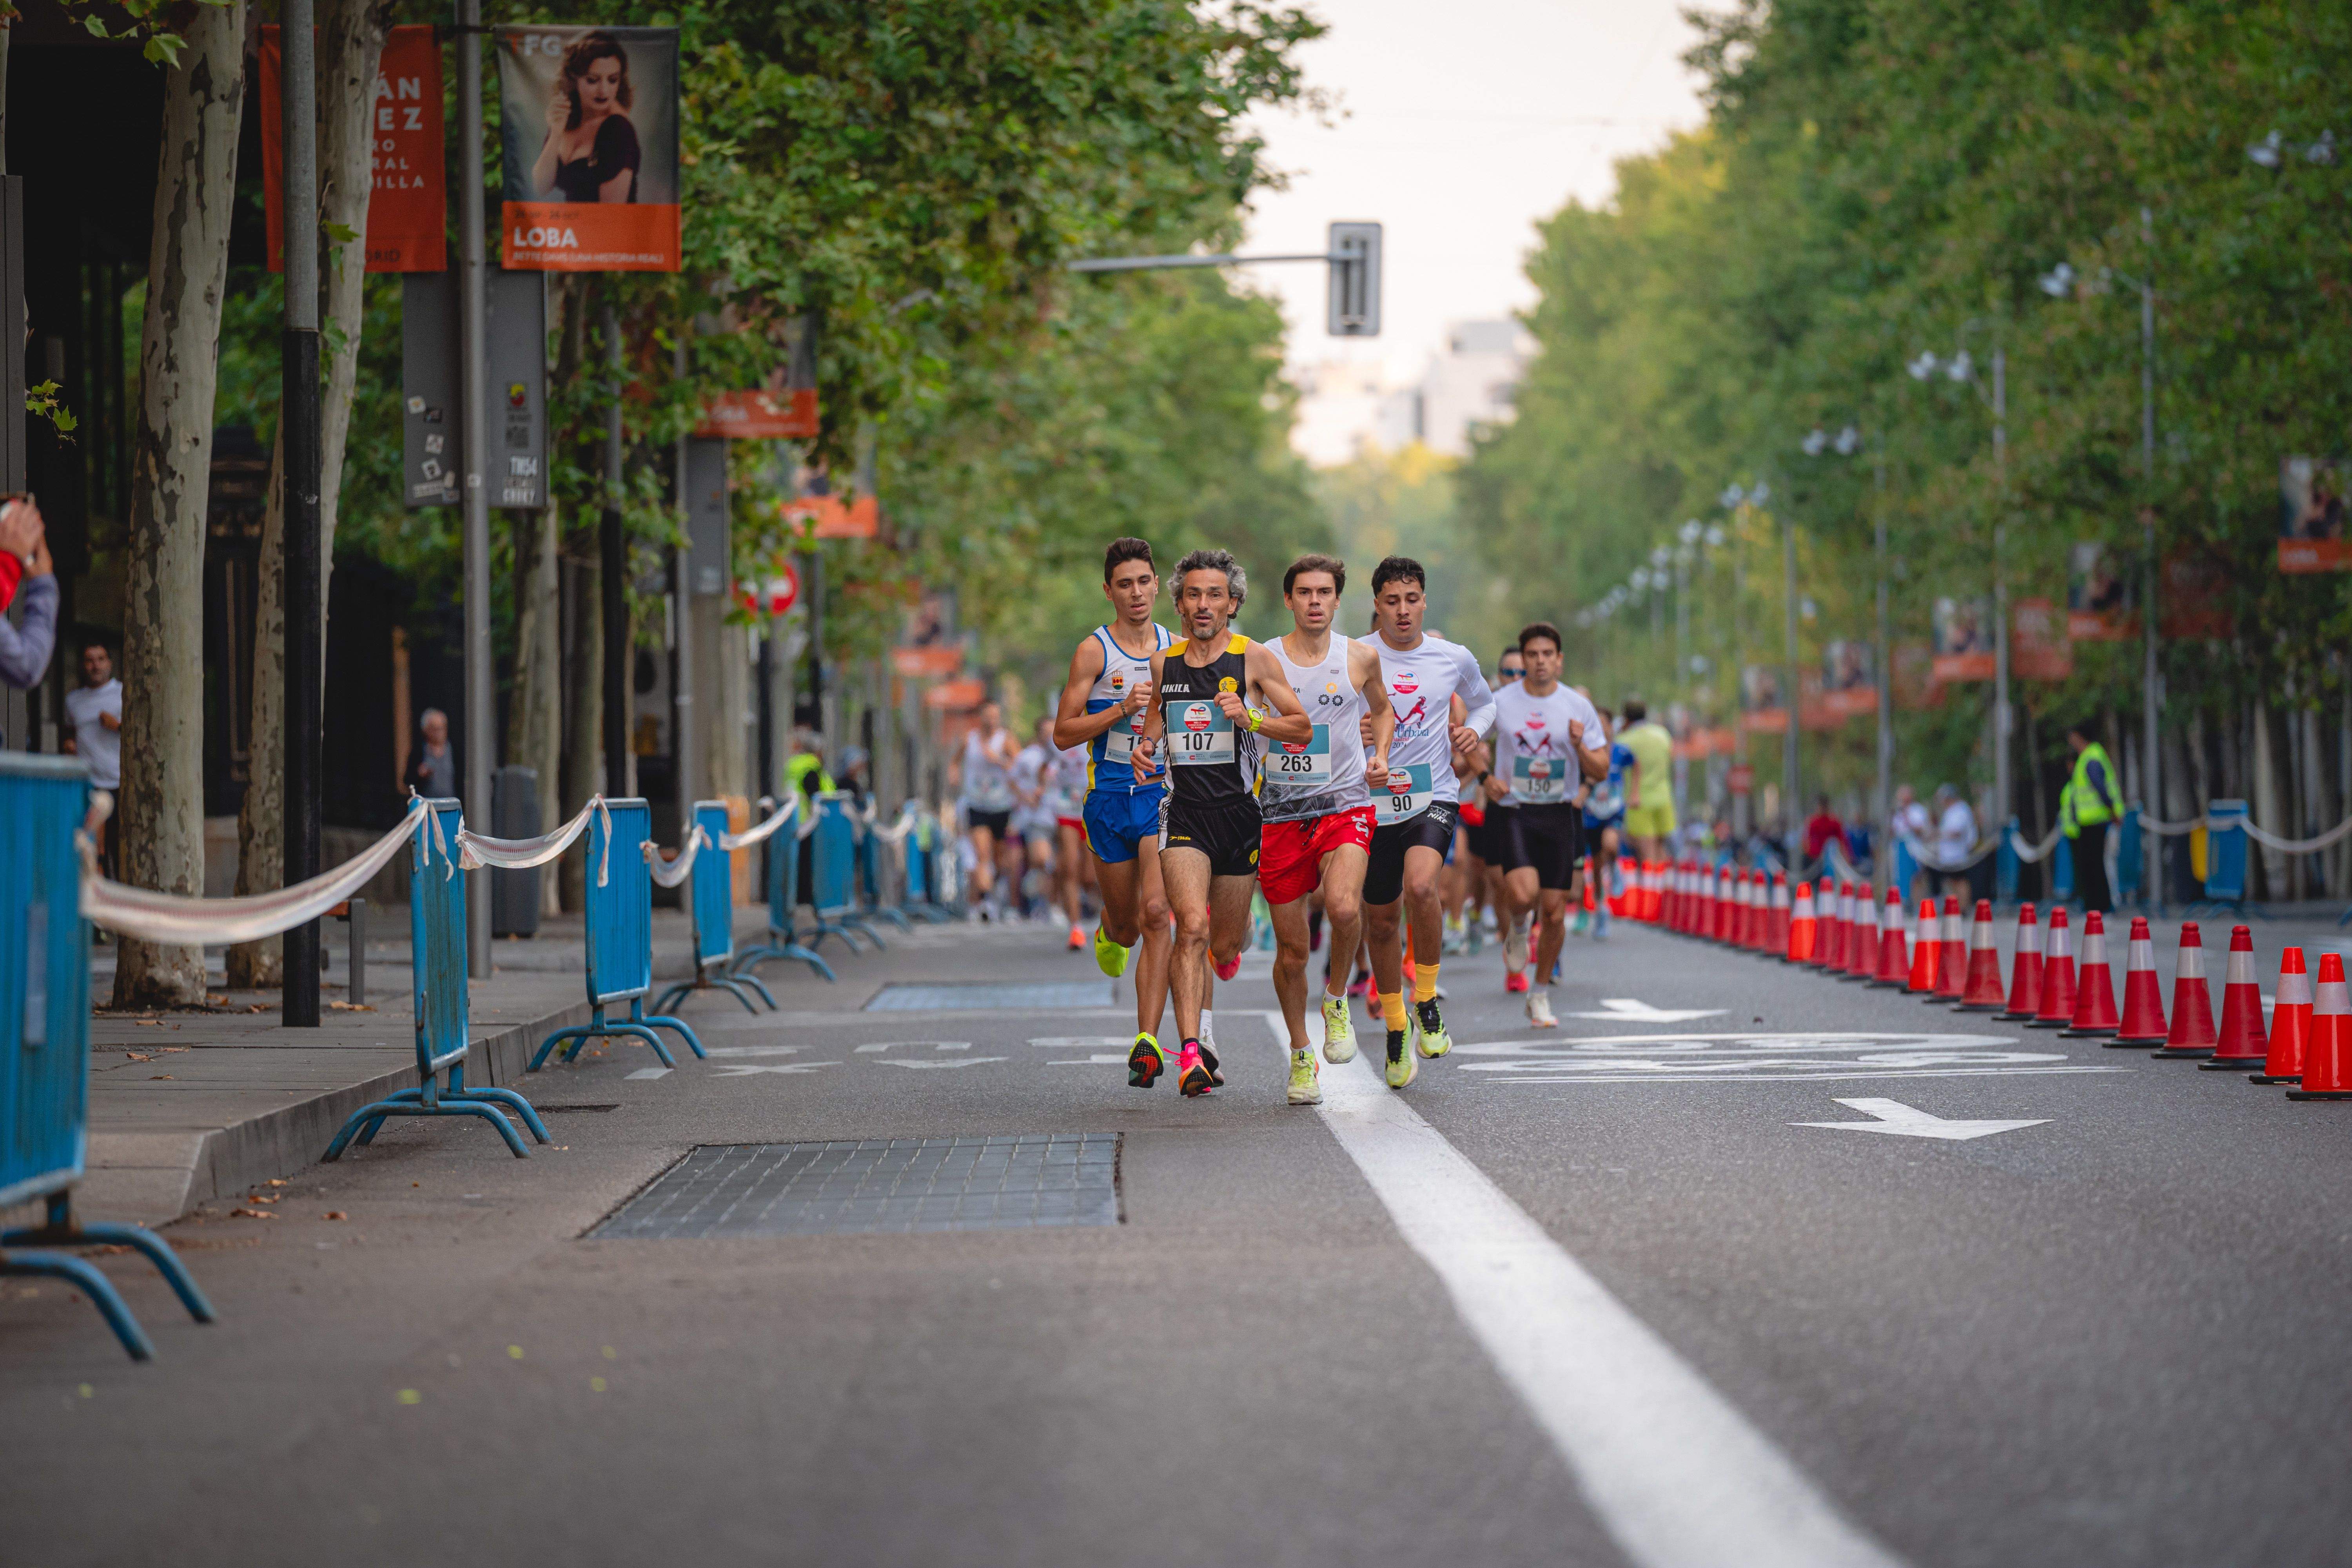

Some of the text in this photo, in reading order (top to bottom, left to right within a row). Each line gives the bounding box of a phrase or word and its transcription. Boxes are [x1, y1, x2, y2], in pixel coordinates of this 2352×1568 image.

[506, 34, 562, 56] TFG
[514, 226, 579, 248] LOBA
[1182, 733, 1214, 751] 107
[1281, 755, 1312, 772] 263
[1526, 779, 1550, 793] 150
[1392, 795, 1412, 812] 90
[1427, 812, 1448, 824] NIKE
